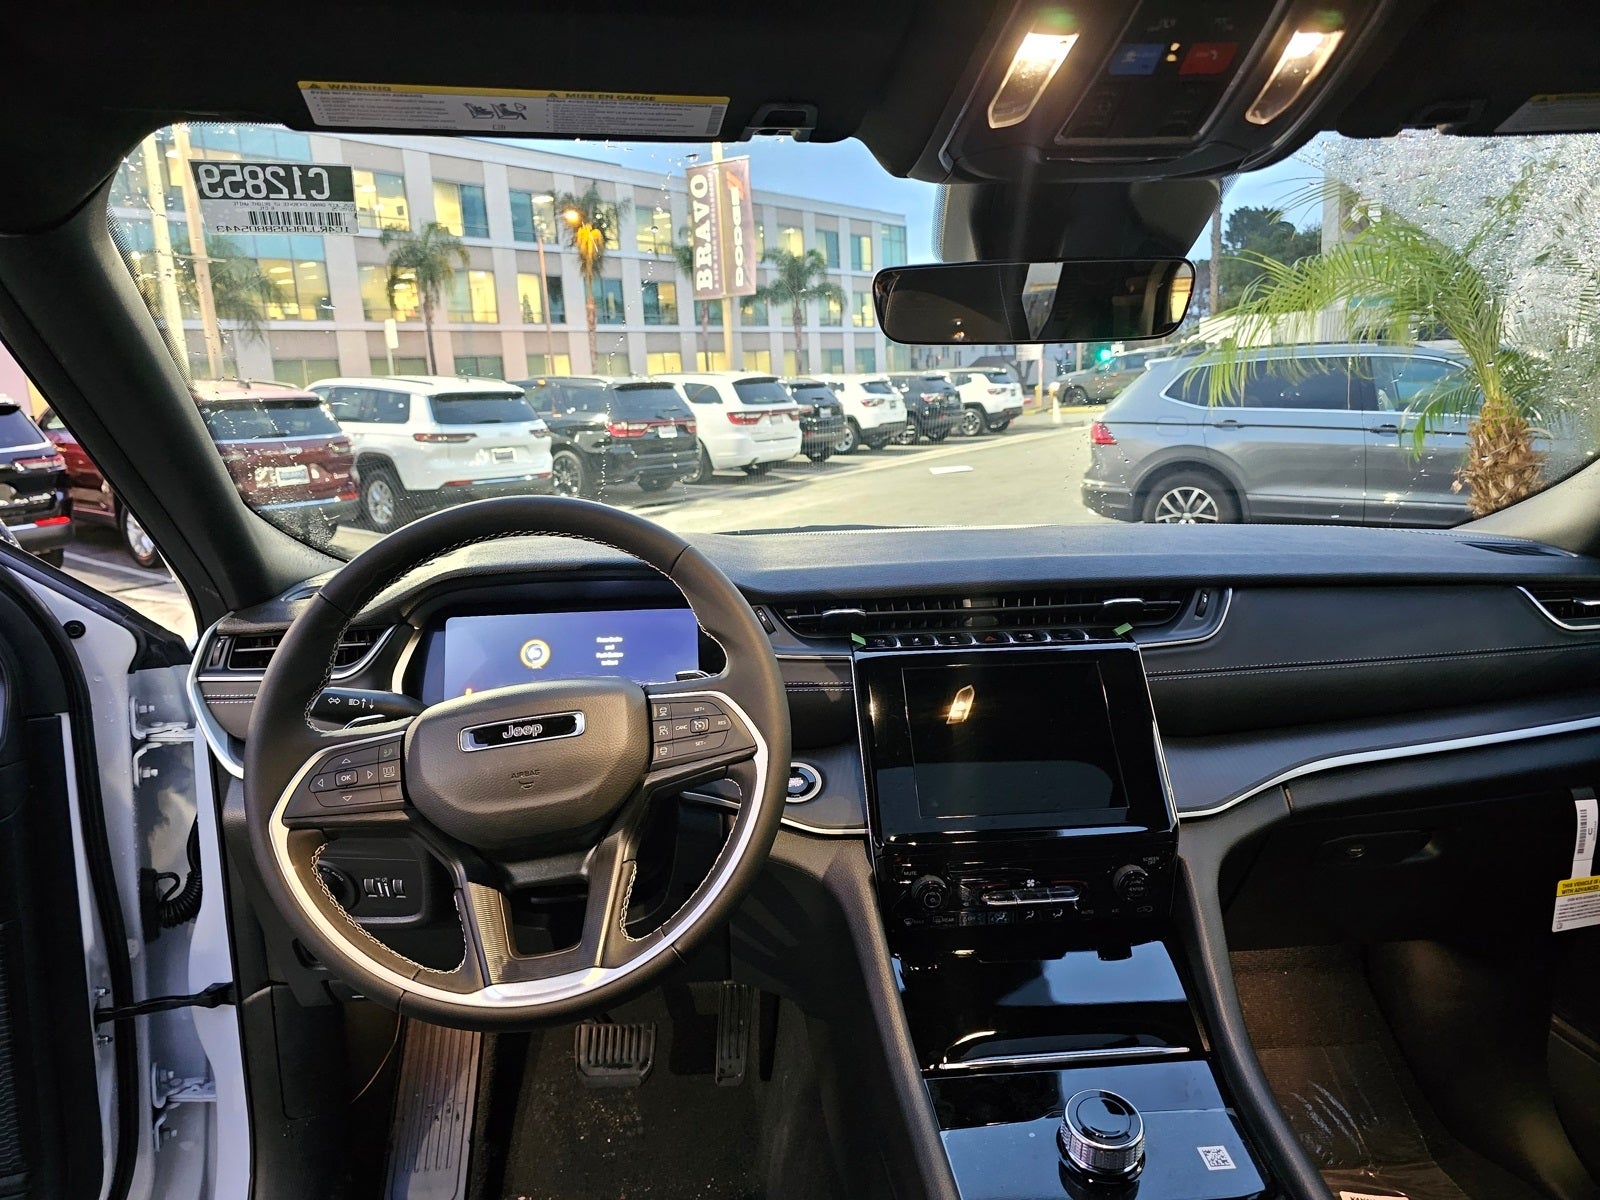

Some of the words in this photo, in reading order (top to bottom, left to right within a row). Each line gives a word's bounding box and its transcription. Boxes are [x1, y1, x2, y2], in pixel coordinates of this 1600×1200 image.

[328, 83, 392, 92] WARNING
[690, 174, 713, 291] BRAVO
[731, 186, 744, 287] DODGE
[502, 723, 543, 739] Jeep
[511, 769, 541, 779] AIRBAG
[1575, 884, 1600, 893] ADVANCED
